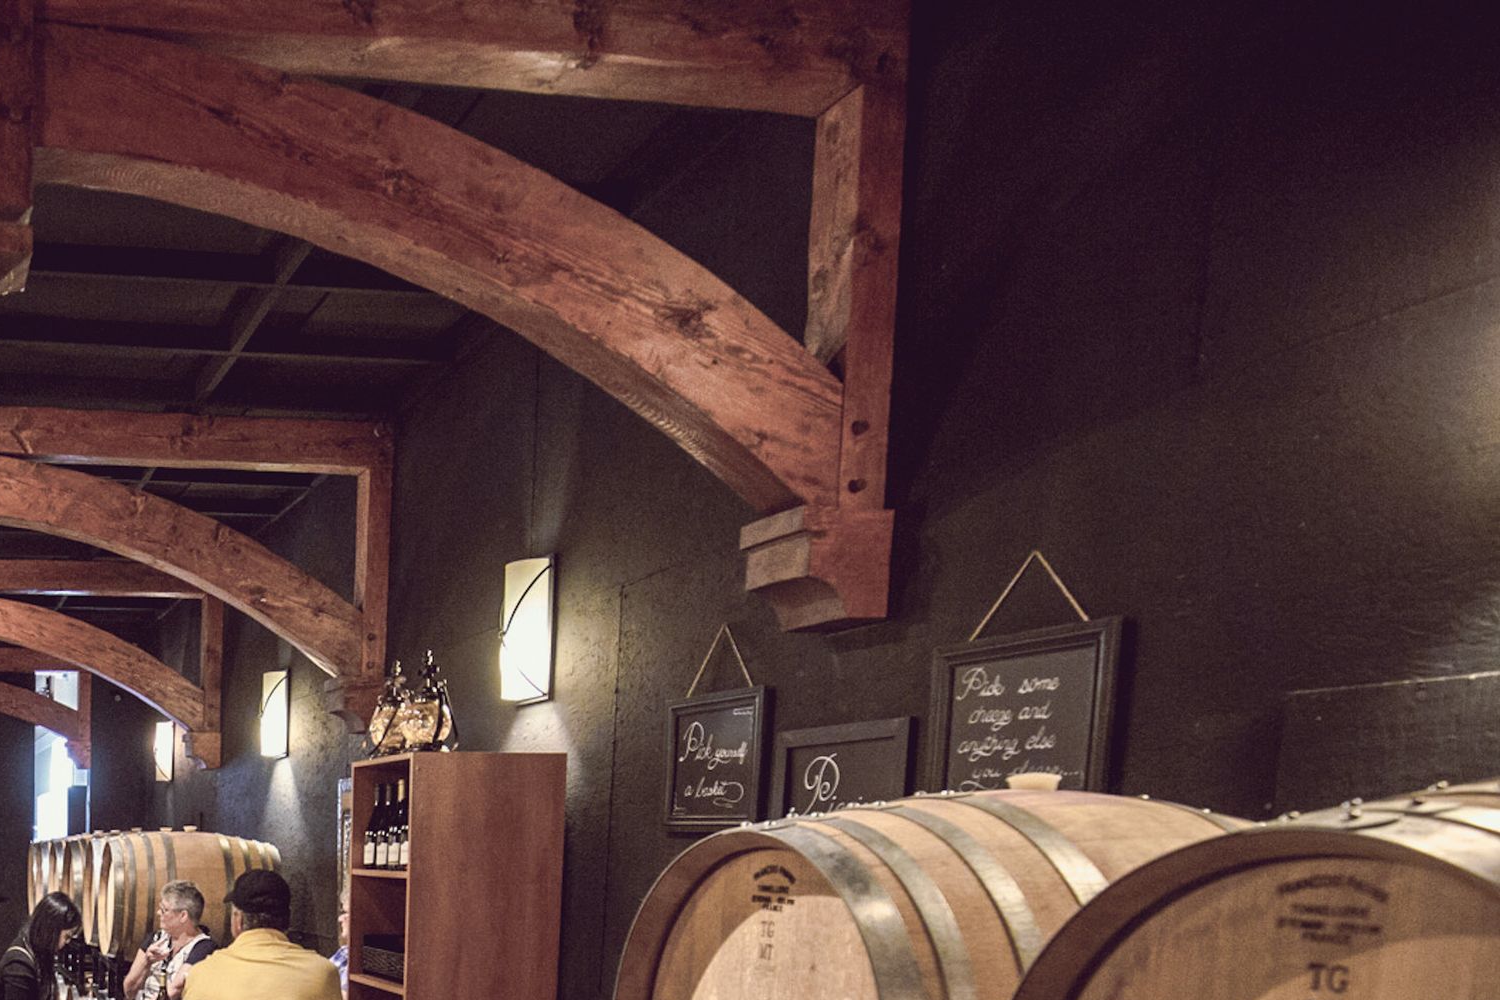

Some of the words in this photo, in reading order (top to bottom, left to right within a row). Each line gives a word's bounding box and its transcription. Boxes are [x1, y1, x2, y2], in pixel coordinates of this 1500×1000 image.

[956, 667, 1005, 700] Pick
[1018, 677, 1060, 694] some
[1018, 700, 1053, 720] and
[679, 721, 714, 762] Pick
[957, 735, 1021, 761] anything
[1025, 725, 1057, 750] else
[1307, 961, 1350, 994] TG
